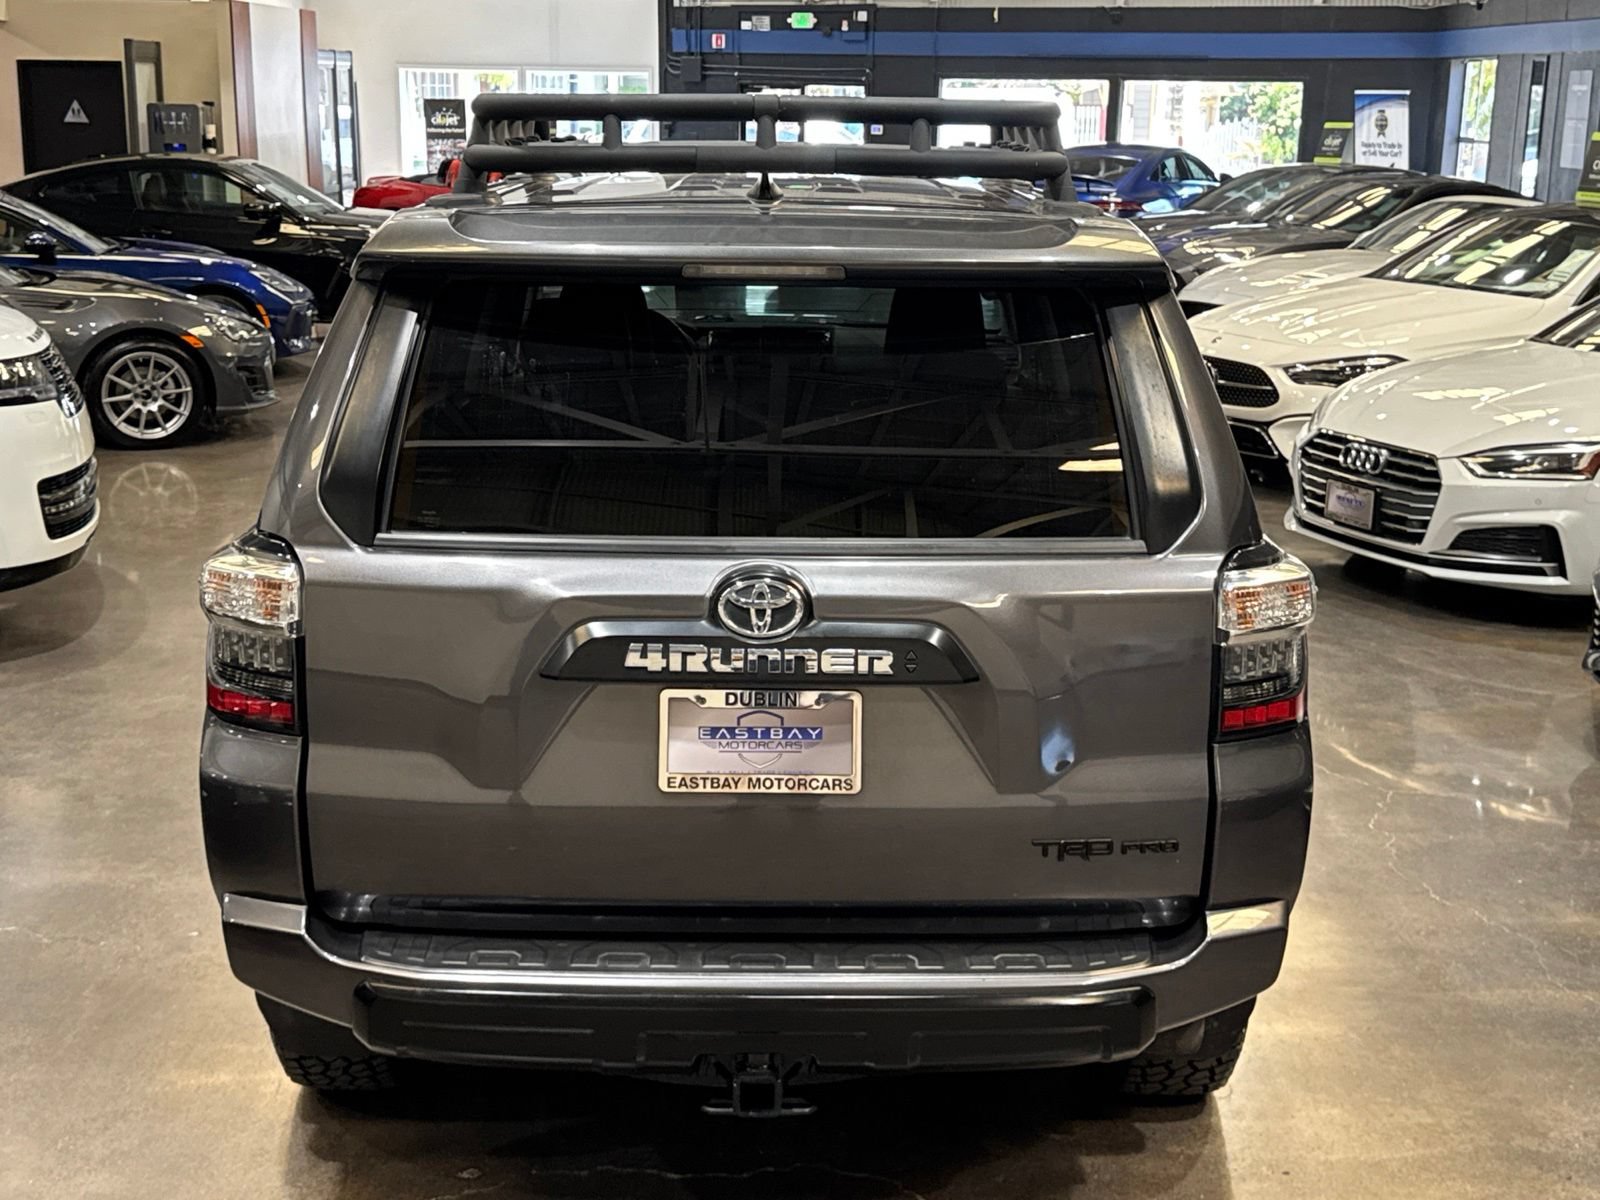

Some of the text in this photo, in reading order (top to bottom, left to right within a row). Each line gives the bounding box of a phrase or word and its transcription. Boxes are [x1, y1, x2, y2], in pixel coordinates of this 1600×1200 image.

[1361, 141, 1376, 150] Ready
[624, 643, 894, 675] 4RUNNER
[725, 692, 797, 707] DUBLIN
[700, 728, 822, 739] EASTBAY
[718, 740, 802, 750] MOTORCARS
[667, 776, 853, 791] EASTBAY MOTORCARS
[1031, 838, 1180, 862] TRD PRO
